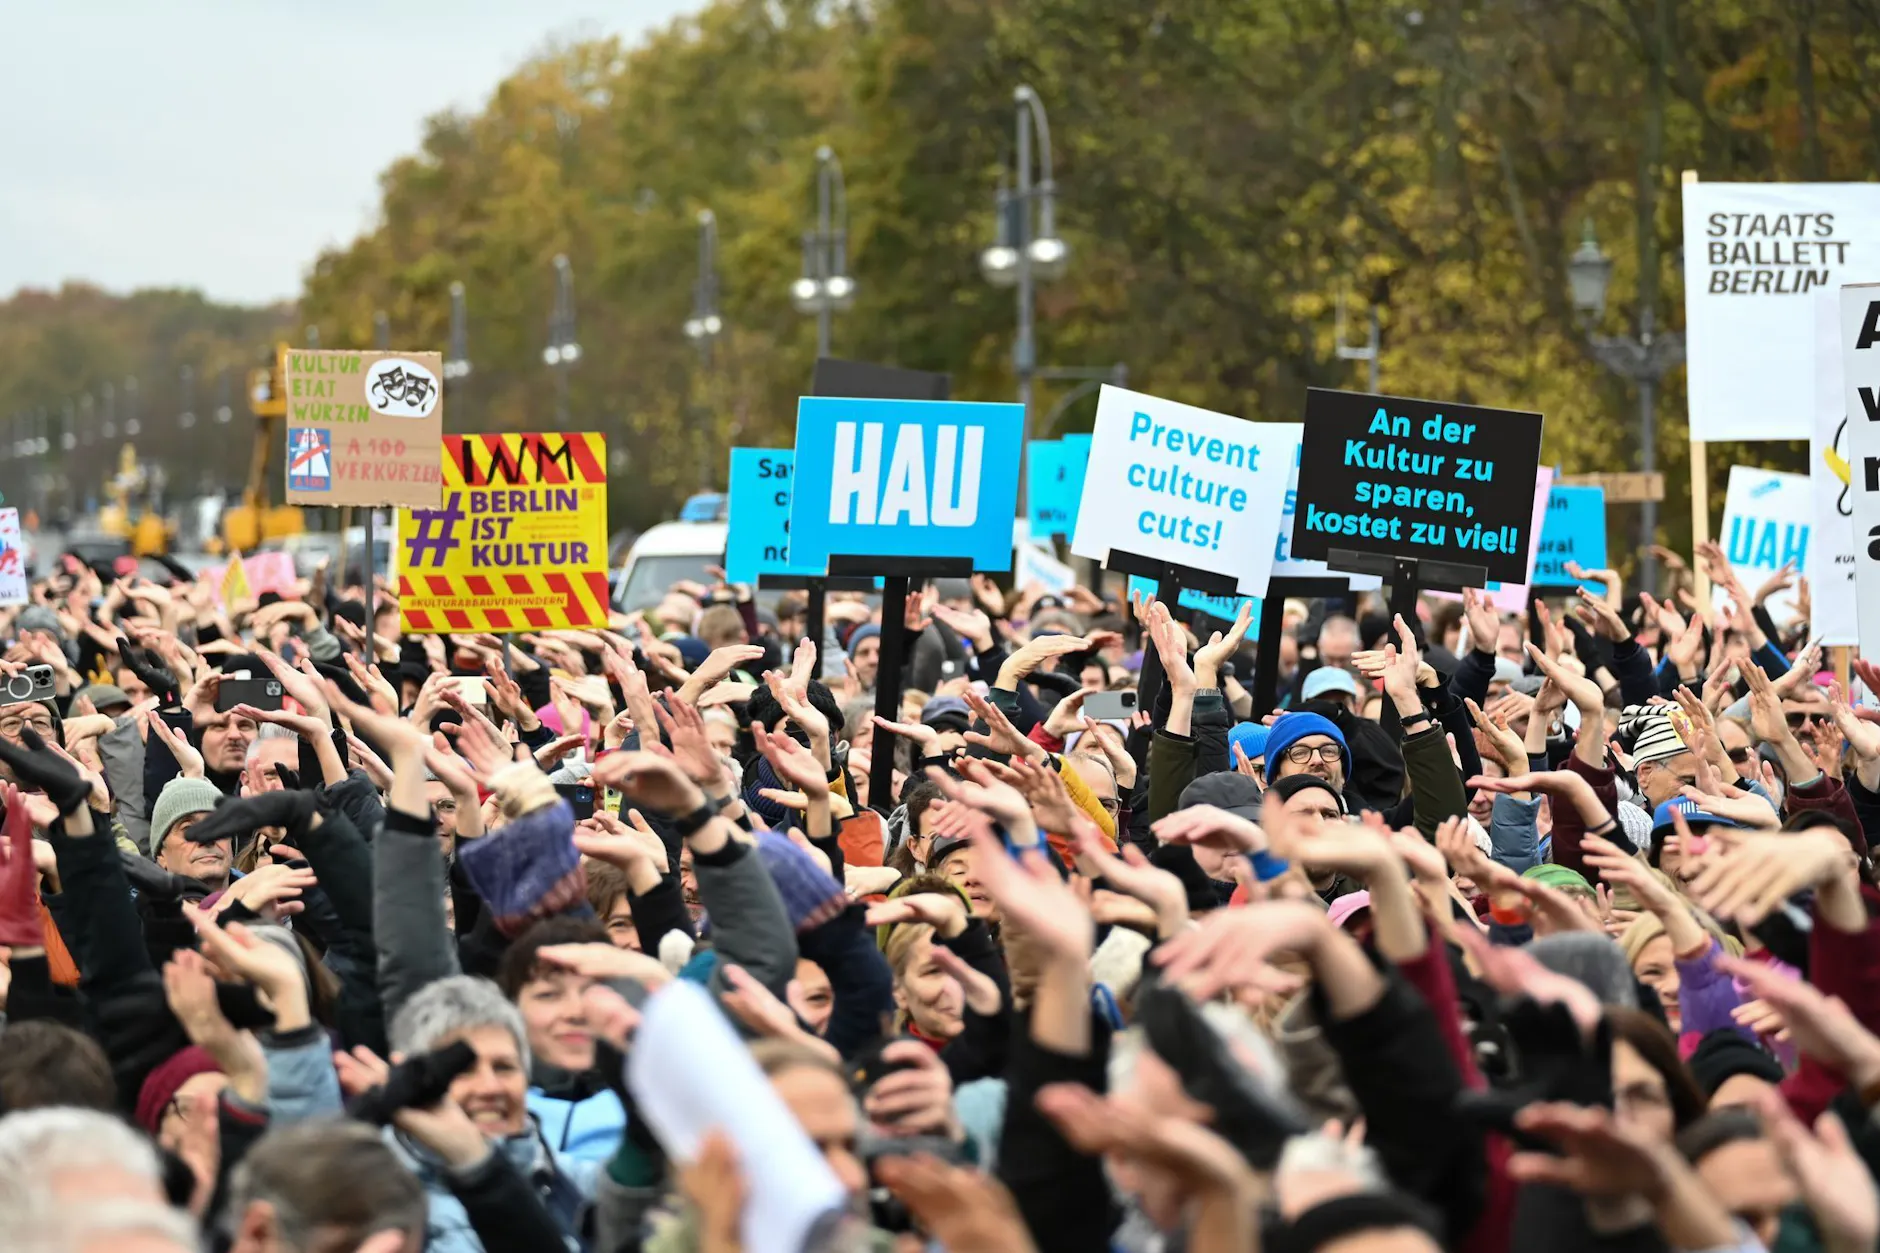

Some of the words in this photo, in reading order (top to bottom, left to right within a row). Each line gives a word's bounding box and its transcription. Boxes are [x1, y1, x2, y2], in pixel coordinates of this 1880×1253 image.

[1706, 213, 1835, 237] STAATS
[1708, 241, 1851, 265] BALLETT
[1708, 270, 1830, 294] BERLIN
[291, 354, 362, 373] KULTUR
[292, 378, 336, 397] ETAT
[1368, 408, 1411, 437] An
[1422, 413, 1476, 445] der
[347, 437, 361, 456] A
[367, 437, 407, 457] 100
[1129, 411, 1261, 472] Prevent
[1344, 439, 1445, 476] Kultur
[1454, 457, 1494, 482] zu
[828, 421, 985, 527] HAU
[1127, 463, 1248, 512] culture
[1354, 480, 1475, 518] sparen,
[470, 488, 578, 513] BERLIN
[471, 517, 514, 540] IST
[1137, 510, 1223, 550] cuts!
[1305, 503, 1402, 541] kostet
[1410, 522, 1446, 546] zu
[1454, 522, 1518, 555] viel!
[472, 542, 589, 567] KULTUR
